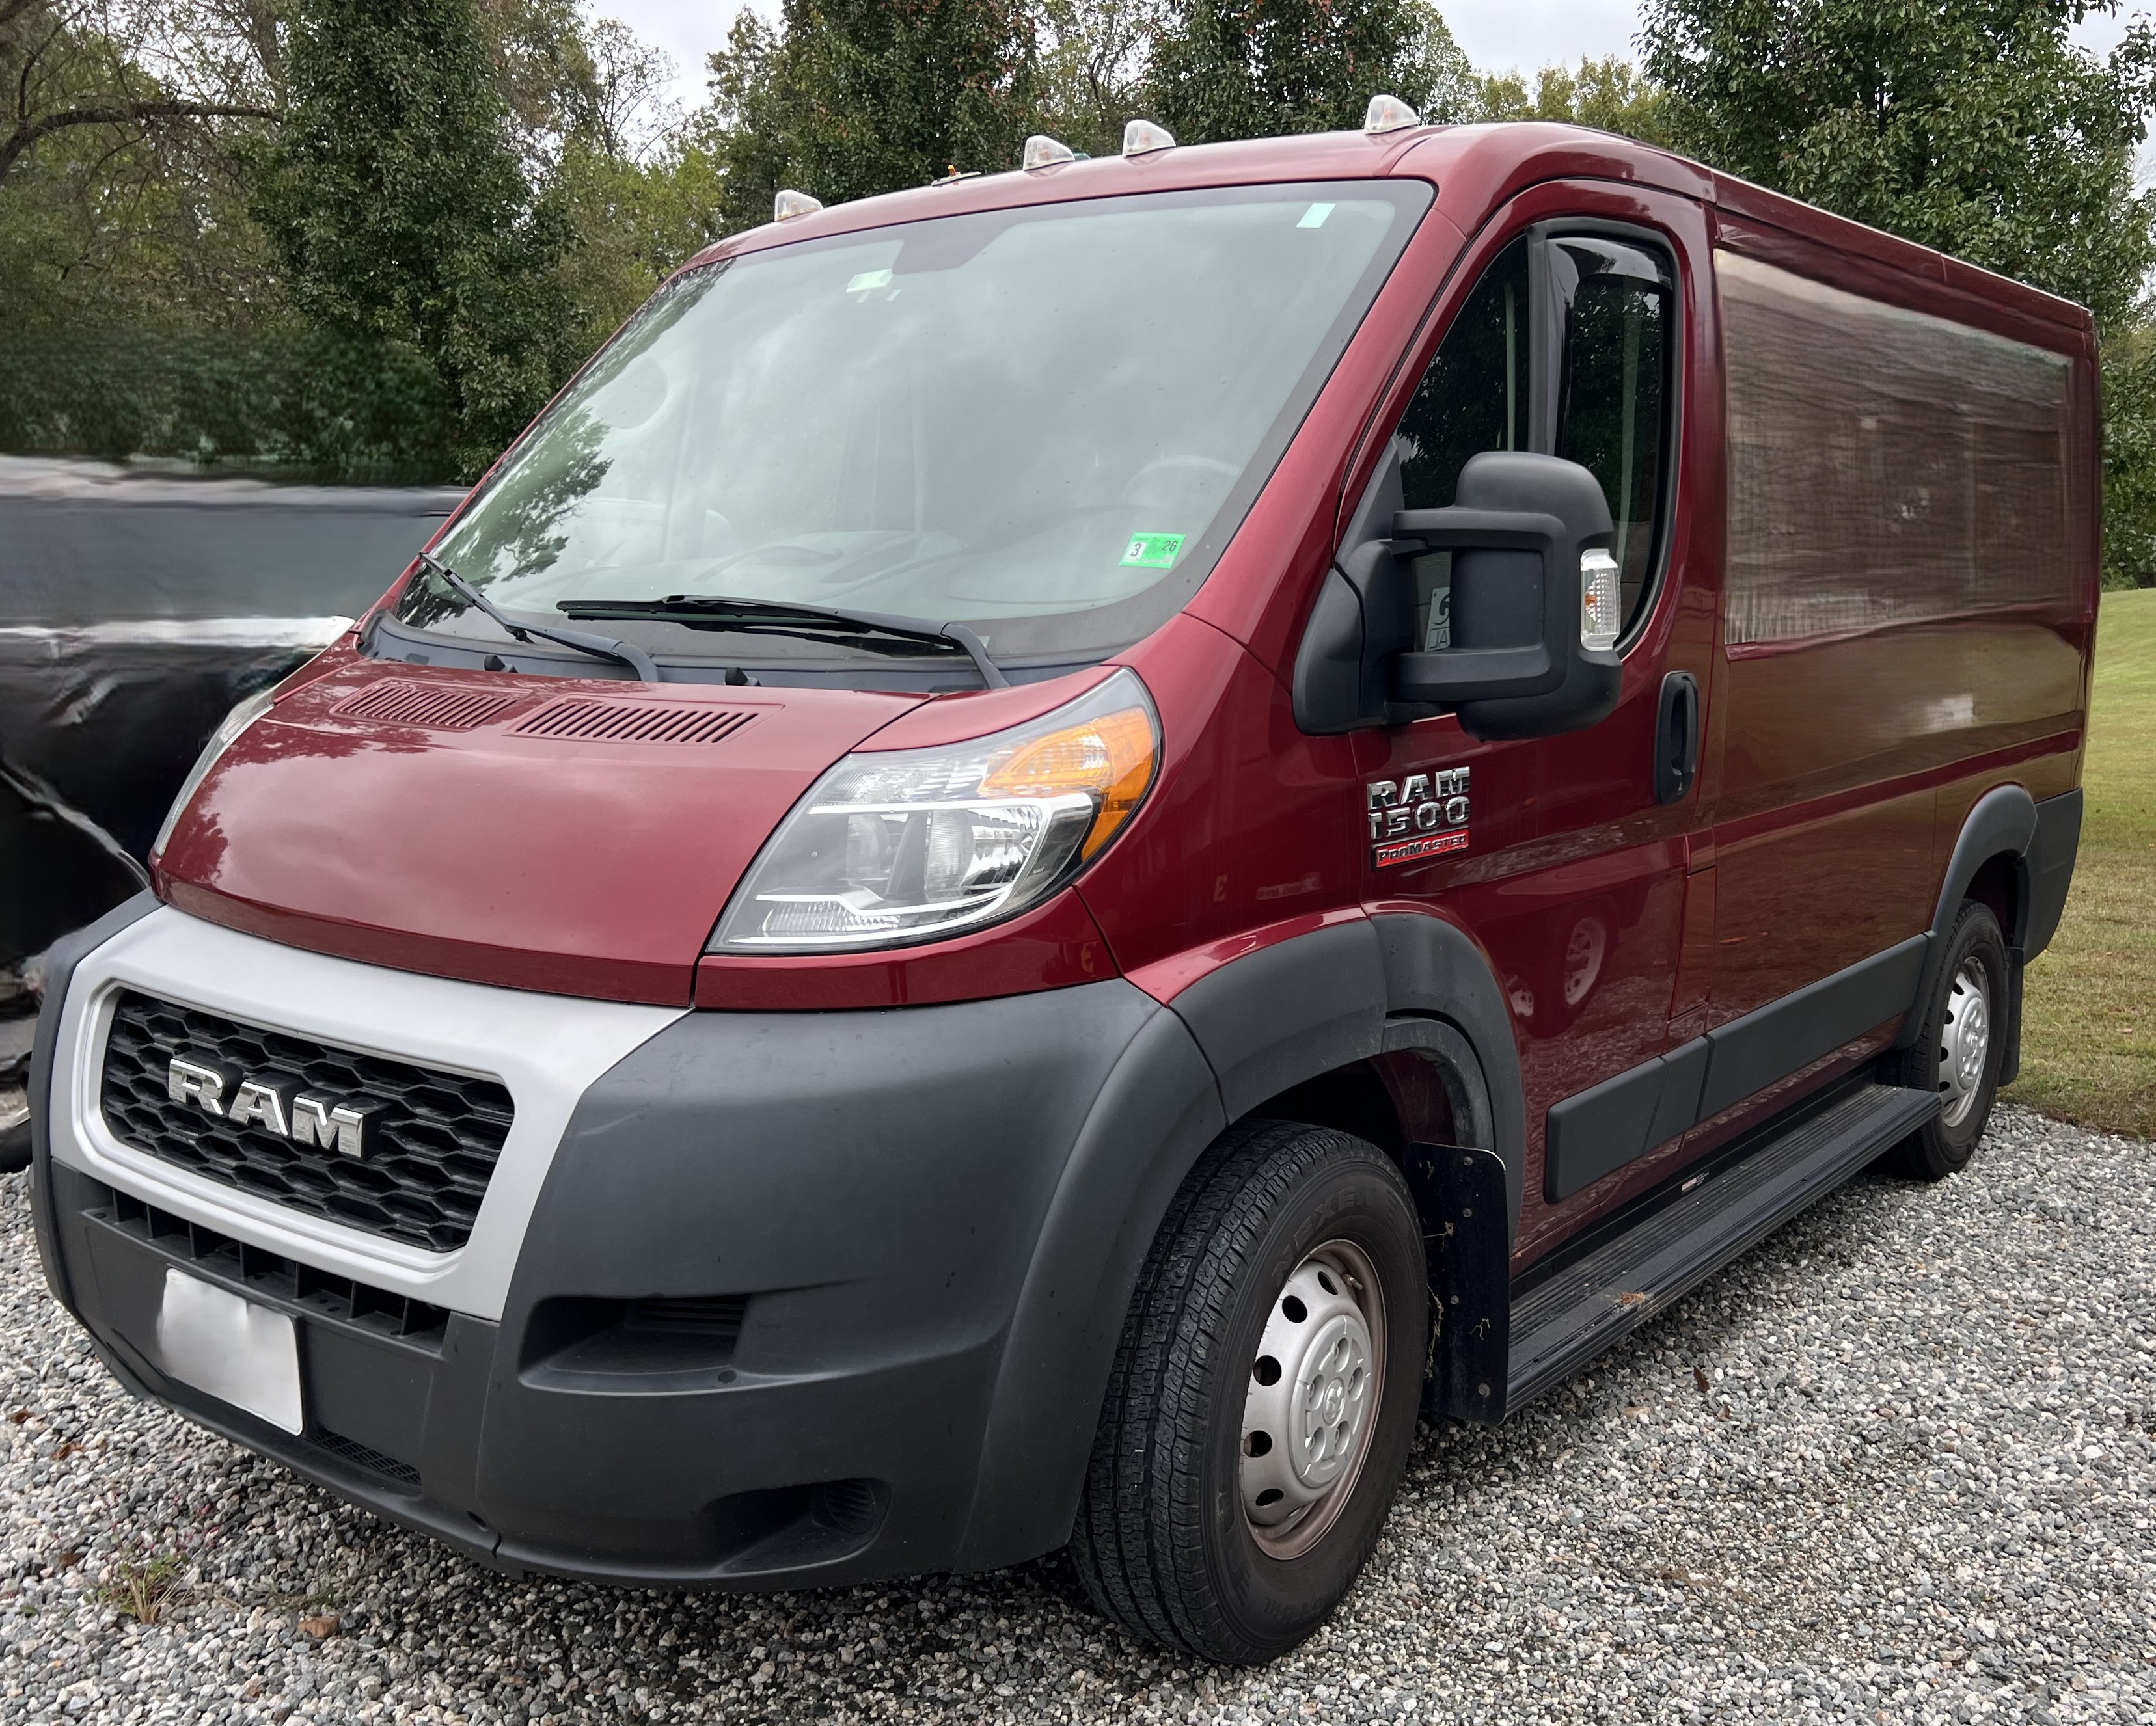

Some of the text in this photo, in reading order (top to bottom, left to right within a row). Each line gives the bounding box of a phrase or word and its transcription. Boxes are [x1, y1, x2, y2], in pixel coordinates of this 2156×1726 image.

[1130, 540, 1179, 557] 3 26
[1367, 766, 1471, 811] RAM
[1367, 796, 1471, 840] 1500
[167, 1058, 364, 1158] RAM
